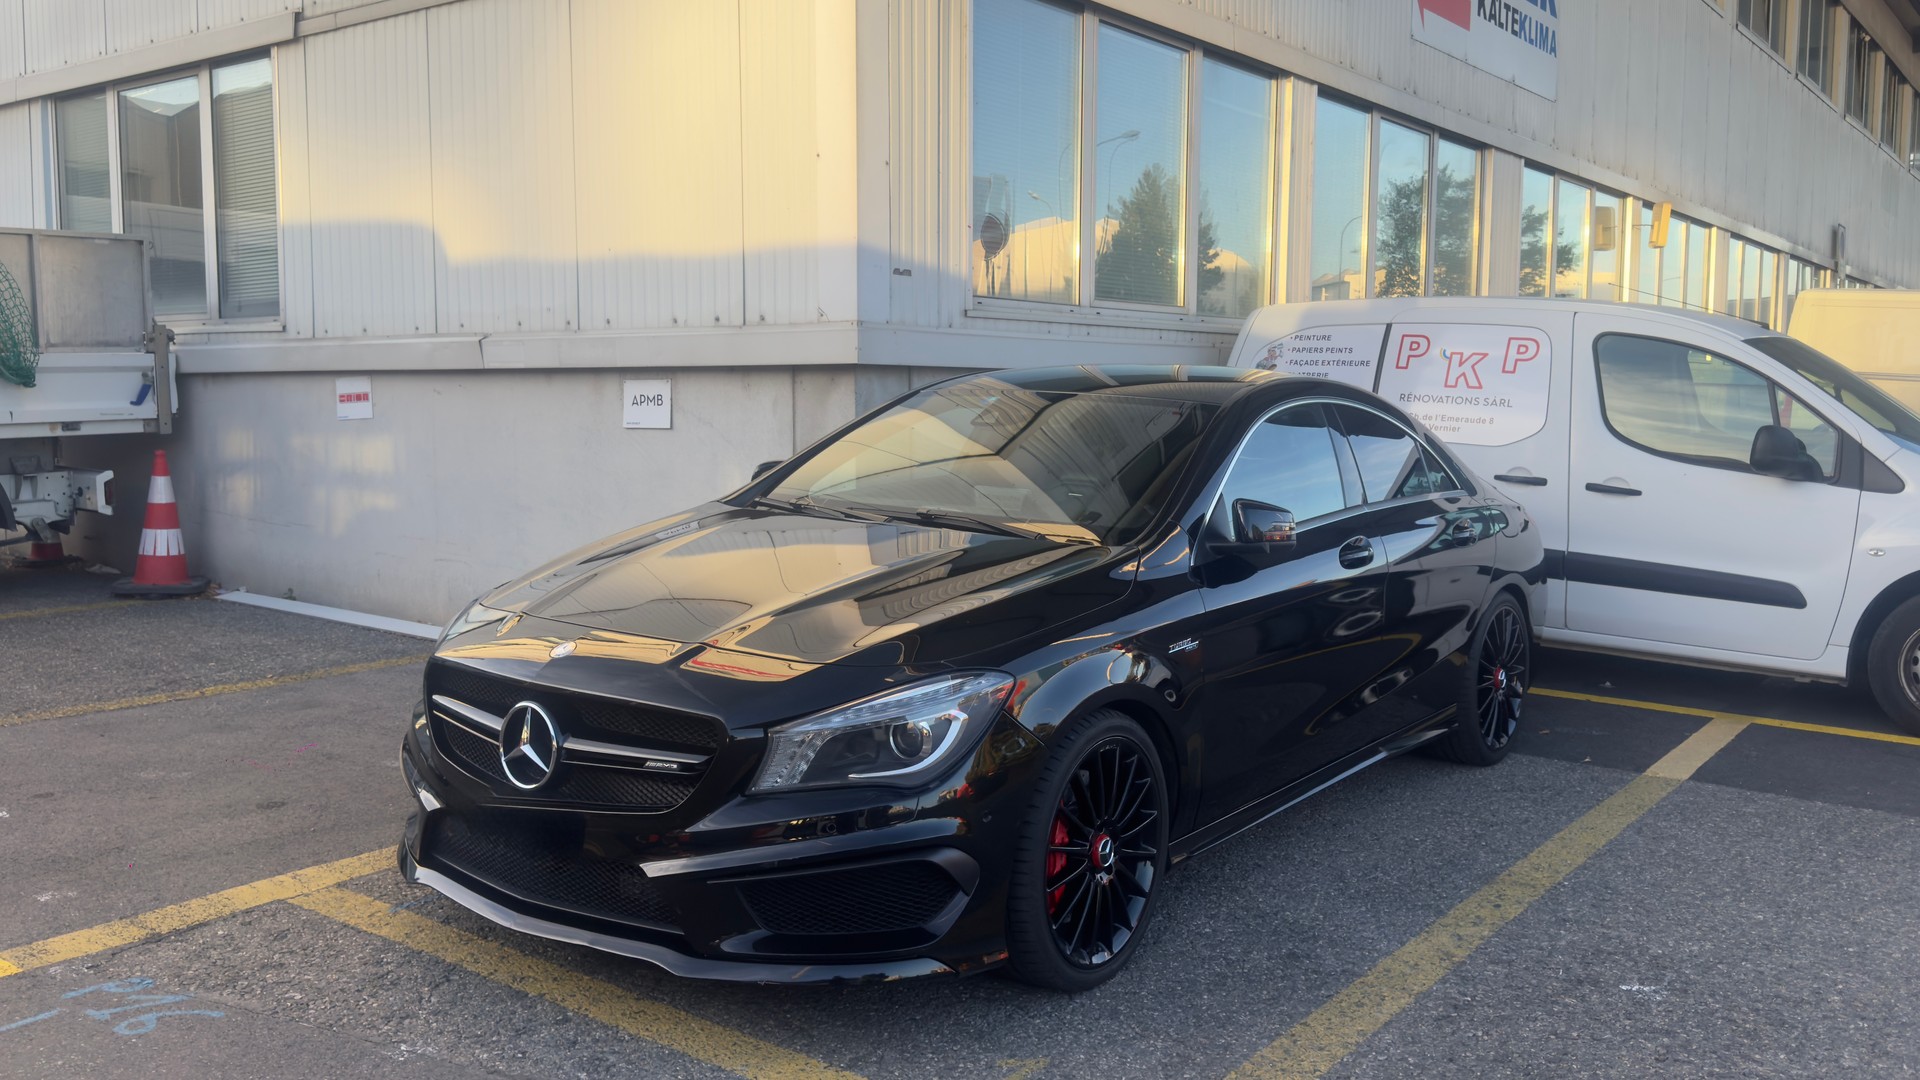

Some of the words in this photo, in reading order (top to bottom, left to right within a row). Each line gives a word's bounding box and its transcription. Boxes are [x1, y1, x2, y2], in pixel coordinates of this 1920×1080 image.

[1321, 359, 1371, 367] EXTÉRIEURE
[632, 394, 663, 406] APMB
[1399, 392, 1480, 406] RÉNOVATIONS
[1488, 417, 1494, 425] 8
[1428, 423, 1461, 433] Vernier
